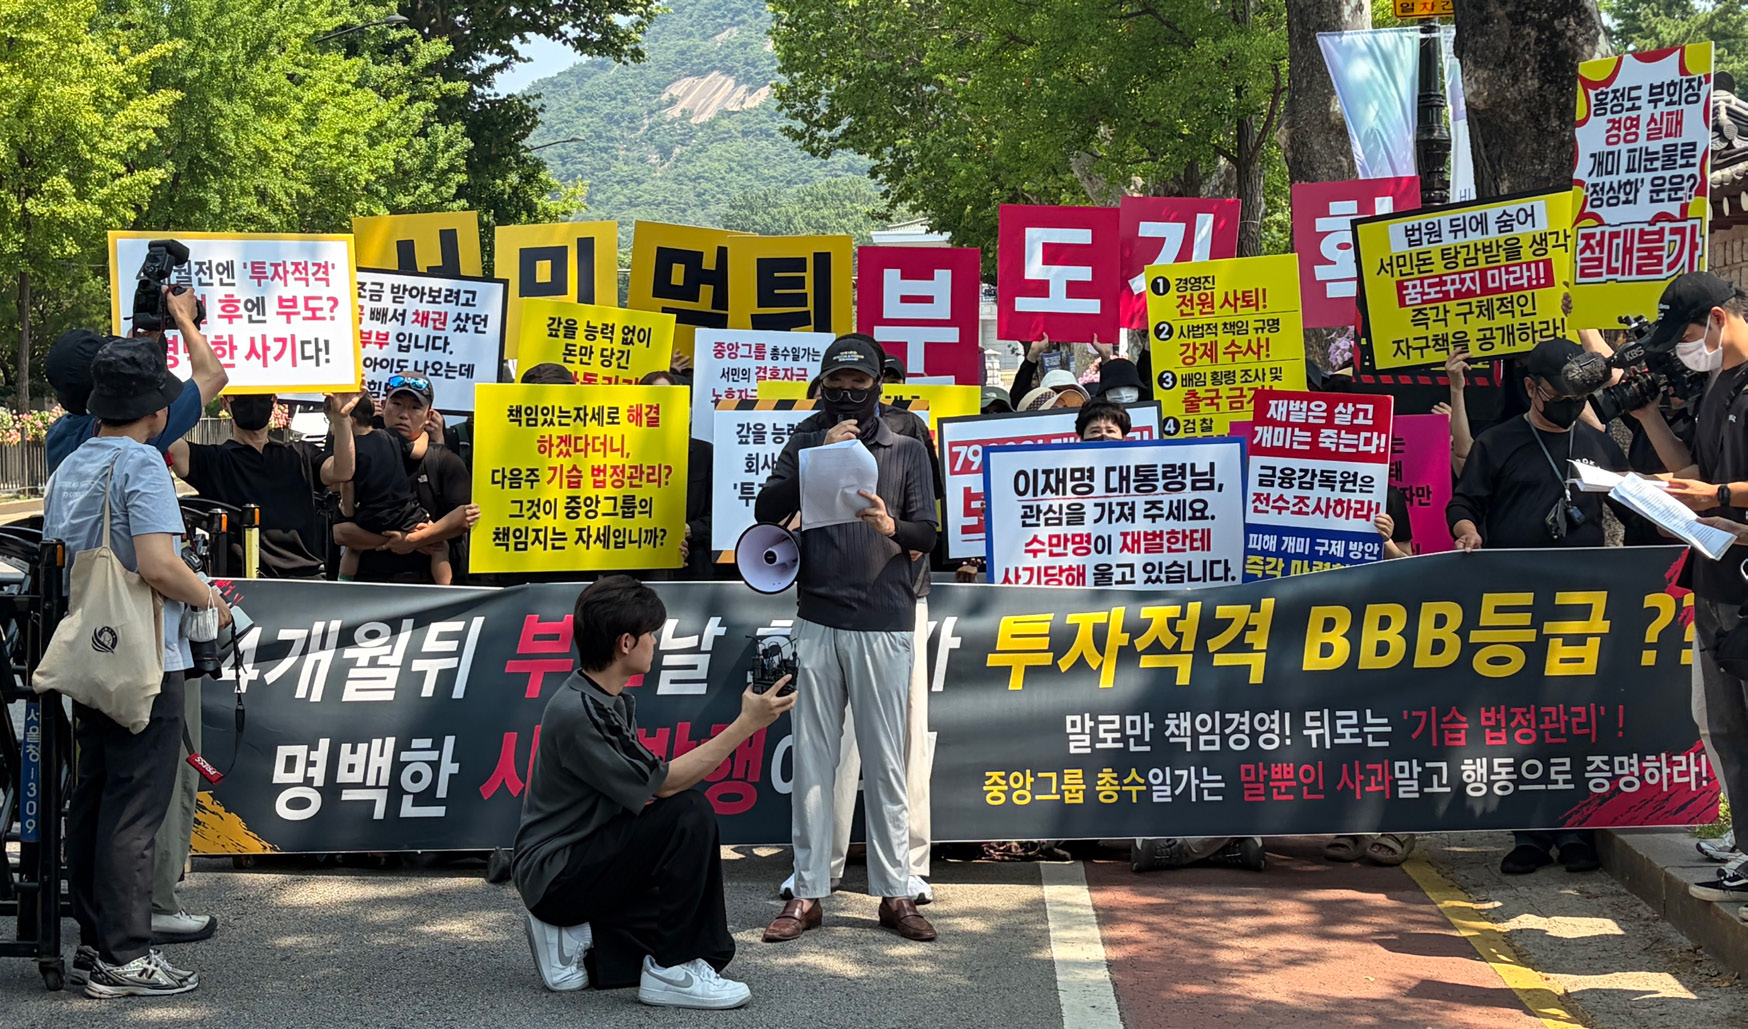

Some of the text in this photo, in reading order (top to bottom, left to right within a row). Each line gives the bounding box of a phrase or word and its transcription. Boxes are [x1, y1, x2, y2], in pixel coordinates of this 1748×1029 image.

[1593, 75, 1702, 117] 홍정도 부회장
[1605, 109, 1684, 146] 경영 실패
[1588, 141, 1697, 178] 개미 피눈물로
[1649, 173, 1698, 203] 운운?
[1404, 205, 1536, 248] 법원 뒤에 숨어
[1128, 213, 1214, 295] 기
[1376, 229, 1571, 278] 서민돈 탕감받을 생각
[1577, 224, 1701, 279] 절대불가
[243, 261, 336, 287] '투자적격'
[1014, 227, 1101, 314] 도
[1175, 275, 1216, 293] 경영진
[1402, 261, 1545, 305] 꿈도꾸지 마라!!
[390, 283, 477, 307] 받아보려고
[1175, 288, 1267, 317] 전원 사퇴!
[217, 294, 267, 324] 후엔
[276, 295, 339, 325] 부도?
[369, 307, 407, 326] 빼서
[411, 309, 448, 331] 채권
[452, 312, 488, 334] 샀던
[1410, 292, 1537, 331] 즉각 구체적인
[547, 316, 652, 348] 갚을 능력 없이
[1178, 322, 1218, 340] 사법적
[1221, 319, 1249, 336] 책임
[1253, 318, 1280, 334] 규명
[1391, 317, 1566, 360] 자구책을 공개하라!
[245, 334, 331, 368] 사기다!
[396, 332, 453, 355] 입니다.
[562, 343, 630, 369] 돈만 당긴
[712, 341, 767, 361] 중앙그룹
[770, 346, 821, 362] 총수일가는
[1178, 337, 1270, 367] 강제 수사!
[1624, 346, 1645, 361] KBS
[414, 360, 475, 380] 나오는데
[720, 367, 751, 383] 서민의
[1181, 372, 1207, 388] 배임
[1210, 370, 1236, 386] 횡령
[1240, 368, 1266, 384] 조사
[1269, 366, 1283, 382] 및
[507, 403, 660, 427] 책임있는자세로 해결
[1182, 388, 1223, 414] 출국
[1267, 399, 1374, 425] 재벌은 살고
[537, 433, 630, 458] 하겠다더니,
[736, 422, 767, 445] 갚을
[1253, 426, 1312, 449] 개미는
[1318, 428, 1386, 453] 죽는다!
[491, 463, 673, 489] 다음주 기습 법정관리?
[1013, 461, 1224, 498] 이재명 대통령님,
[1258, 465, 1375, 493] 금융감독원은
[508, 494, 654, 520] 그것이 중앙그룹의
[1020, 499, 1216, 528] 관심을 가져 주세요.
[1252, 492, 1381, 522] 전수조사하라!
[492, 524, 667, 551] 책임지는 자세입니까?
[1024, 528, 1211, 559] 수만명이 재벌한테
[1248, 533, 1380, 560] 피해 개미 구제 방안
[1000, 559, 1236, 586] 사기당해 울고 있습니다.
[1245, 554, 1285, 578] 즉각
[217, 616, 485, 702] 4개월뒤
[505, 613, 727, 699] 부날
[986, 597, 1275, 690] 투자적격
[1302, 590, 1611, 678] BBB등급
[1065, 712, 1153, 754] 말로만
[1164, 709, 1291, 752] 책임경영!
[1303, 708, 1392, 750] 뒤로는
[1403, 705, 1469, 747] '기습
[272, 735, 460, 821] 명백한
[982, 751, 1709, 806] 중앙그룹 총수일가는 말뿐인 사과말고 행동으로 증명하라!
